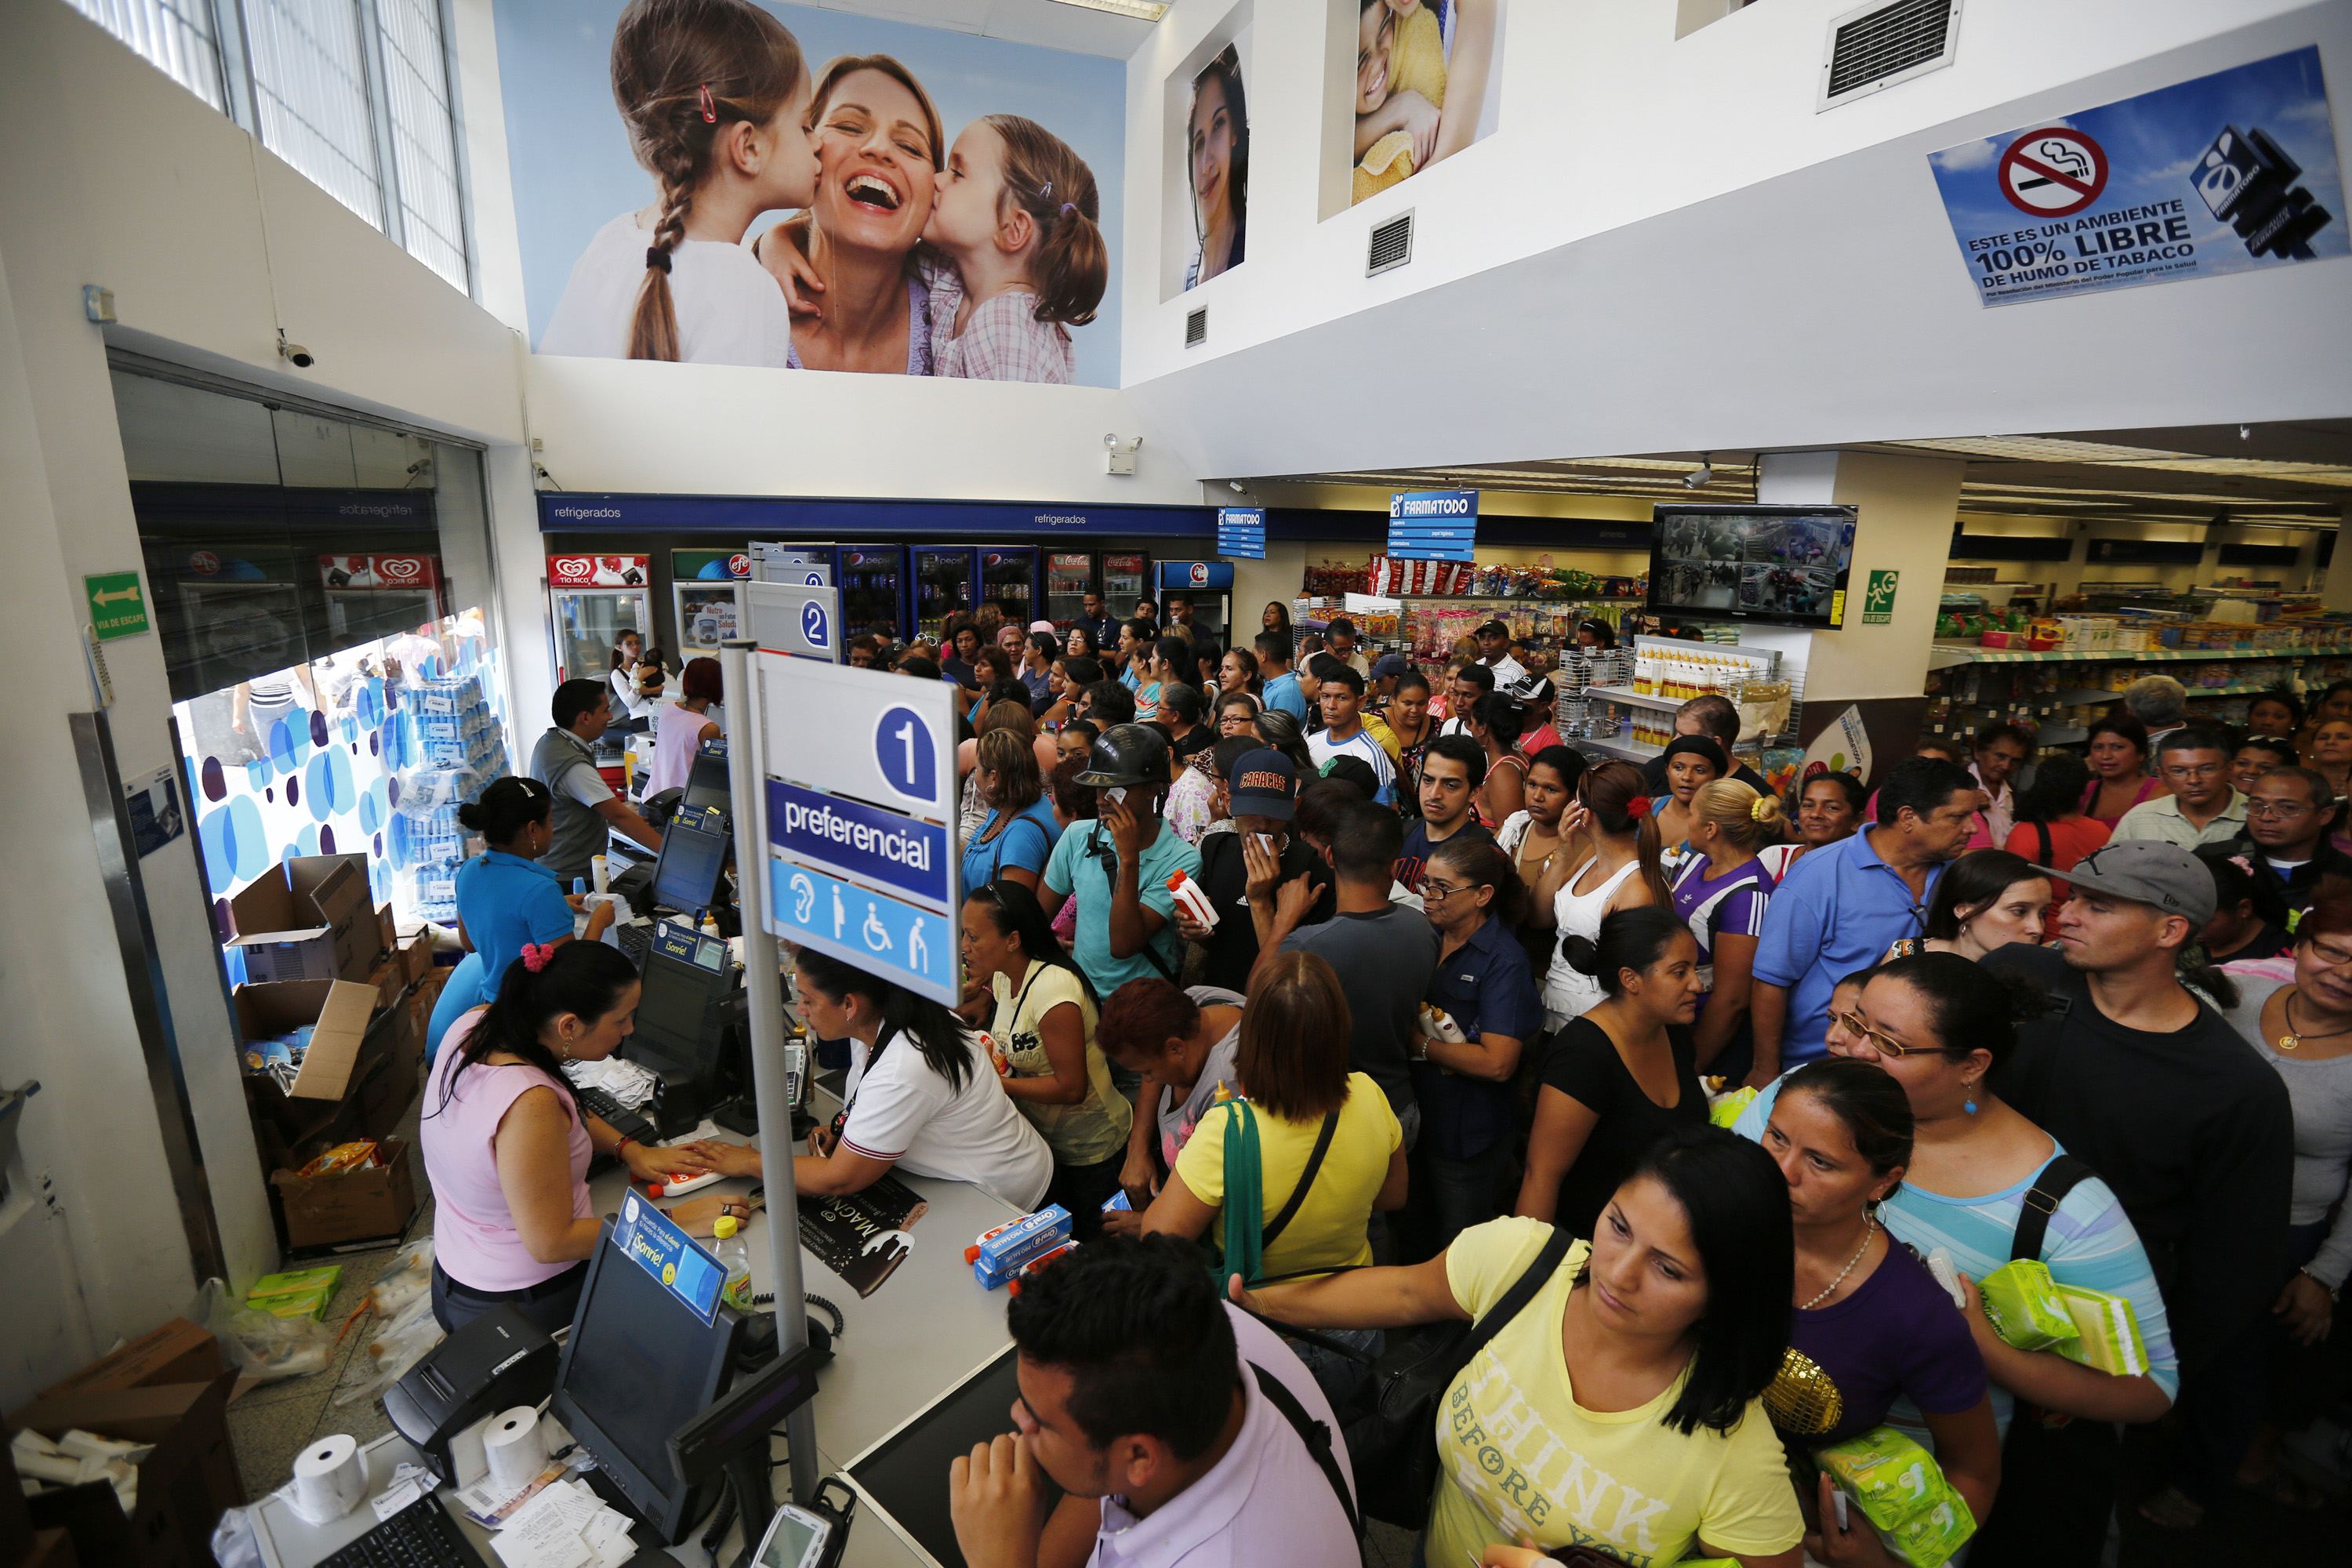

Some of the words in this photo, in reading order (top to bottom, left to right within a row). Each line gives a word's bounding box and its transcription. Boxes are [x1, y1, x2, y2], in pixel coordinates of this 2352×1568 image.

[1969, 234, 2011, 252] ESTE
[2013, 228, 2038, 243] ES
[2042, 222, 2071, 238] UN
[2075, 199, 2184, 232] AMBIENTE
[1975, 240, 2067, 273] 100%
[2074, 216, 2191, 257] LIBRE
[1982, 276, 2007, 289] DE
[2011, 263, 2070, 285] HUMO
[2075, 259, 2102, 274] DE
[2104, 244, 2194, 268] TABACO
[2045, 278, 2080, 289] Ministerio
[2093, 273, 2114, 282] Poder
[2116, 269, 2145, 279] Popular
[2146, 267, 2162, 275] para
[2173, 260, 2197, 270] Salud
[555, 506, 621, 519] refrigerados
[1403, 499, 1468, 515] FARMATODO
[1034, 514, 1087, 525] refrigerados
[1226, 514, 1260, 525] FARMATODO
[731, 557, 749, 572] efe
[866, 557, 891, 565] pepsi
[96, 620, 110, 630] VIA
[111, 619, 119, 628] DE
[121, 614, 146, 626] ESCAPE
[808, 608, 822, 640] 2
[895, 720, 915, 784] 1
[1239, 771, 1286, 791] CARACAS
[784, 801, 931, 872] preferencial
[665, 941, 687, 956] ¡Sonríe!
[1011, 1030, 1039, 1053] 85
[821, 1192, 880, 1238] MAGNU
[1025, 1211, 1054, 1230] Oral-B
[1034, 1229, 1055, 1245] Oral-B
[632, 1232, 665, 1268] ¡Sonríe!
[1450, 1380, 1552, 1527] BEFORE
[1470, 1350, 1670, 1553] THINK
